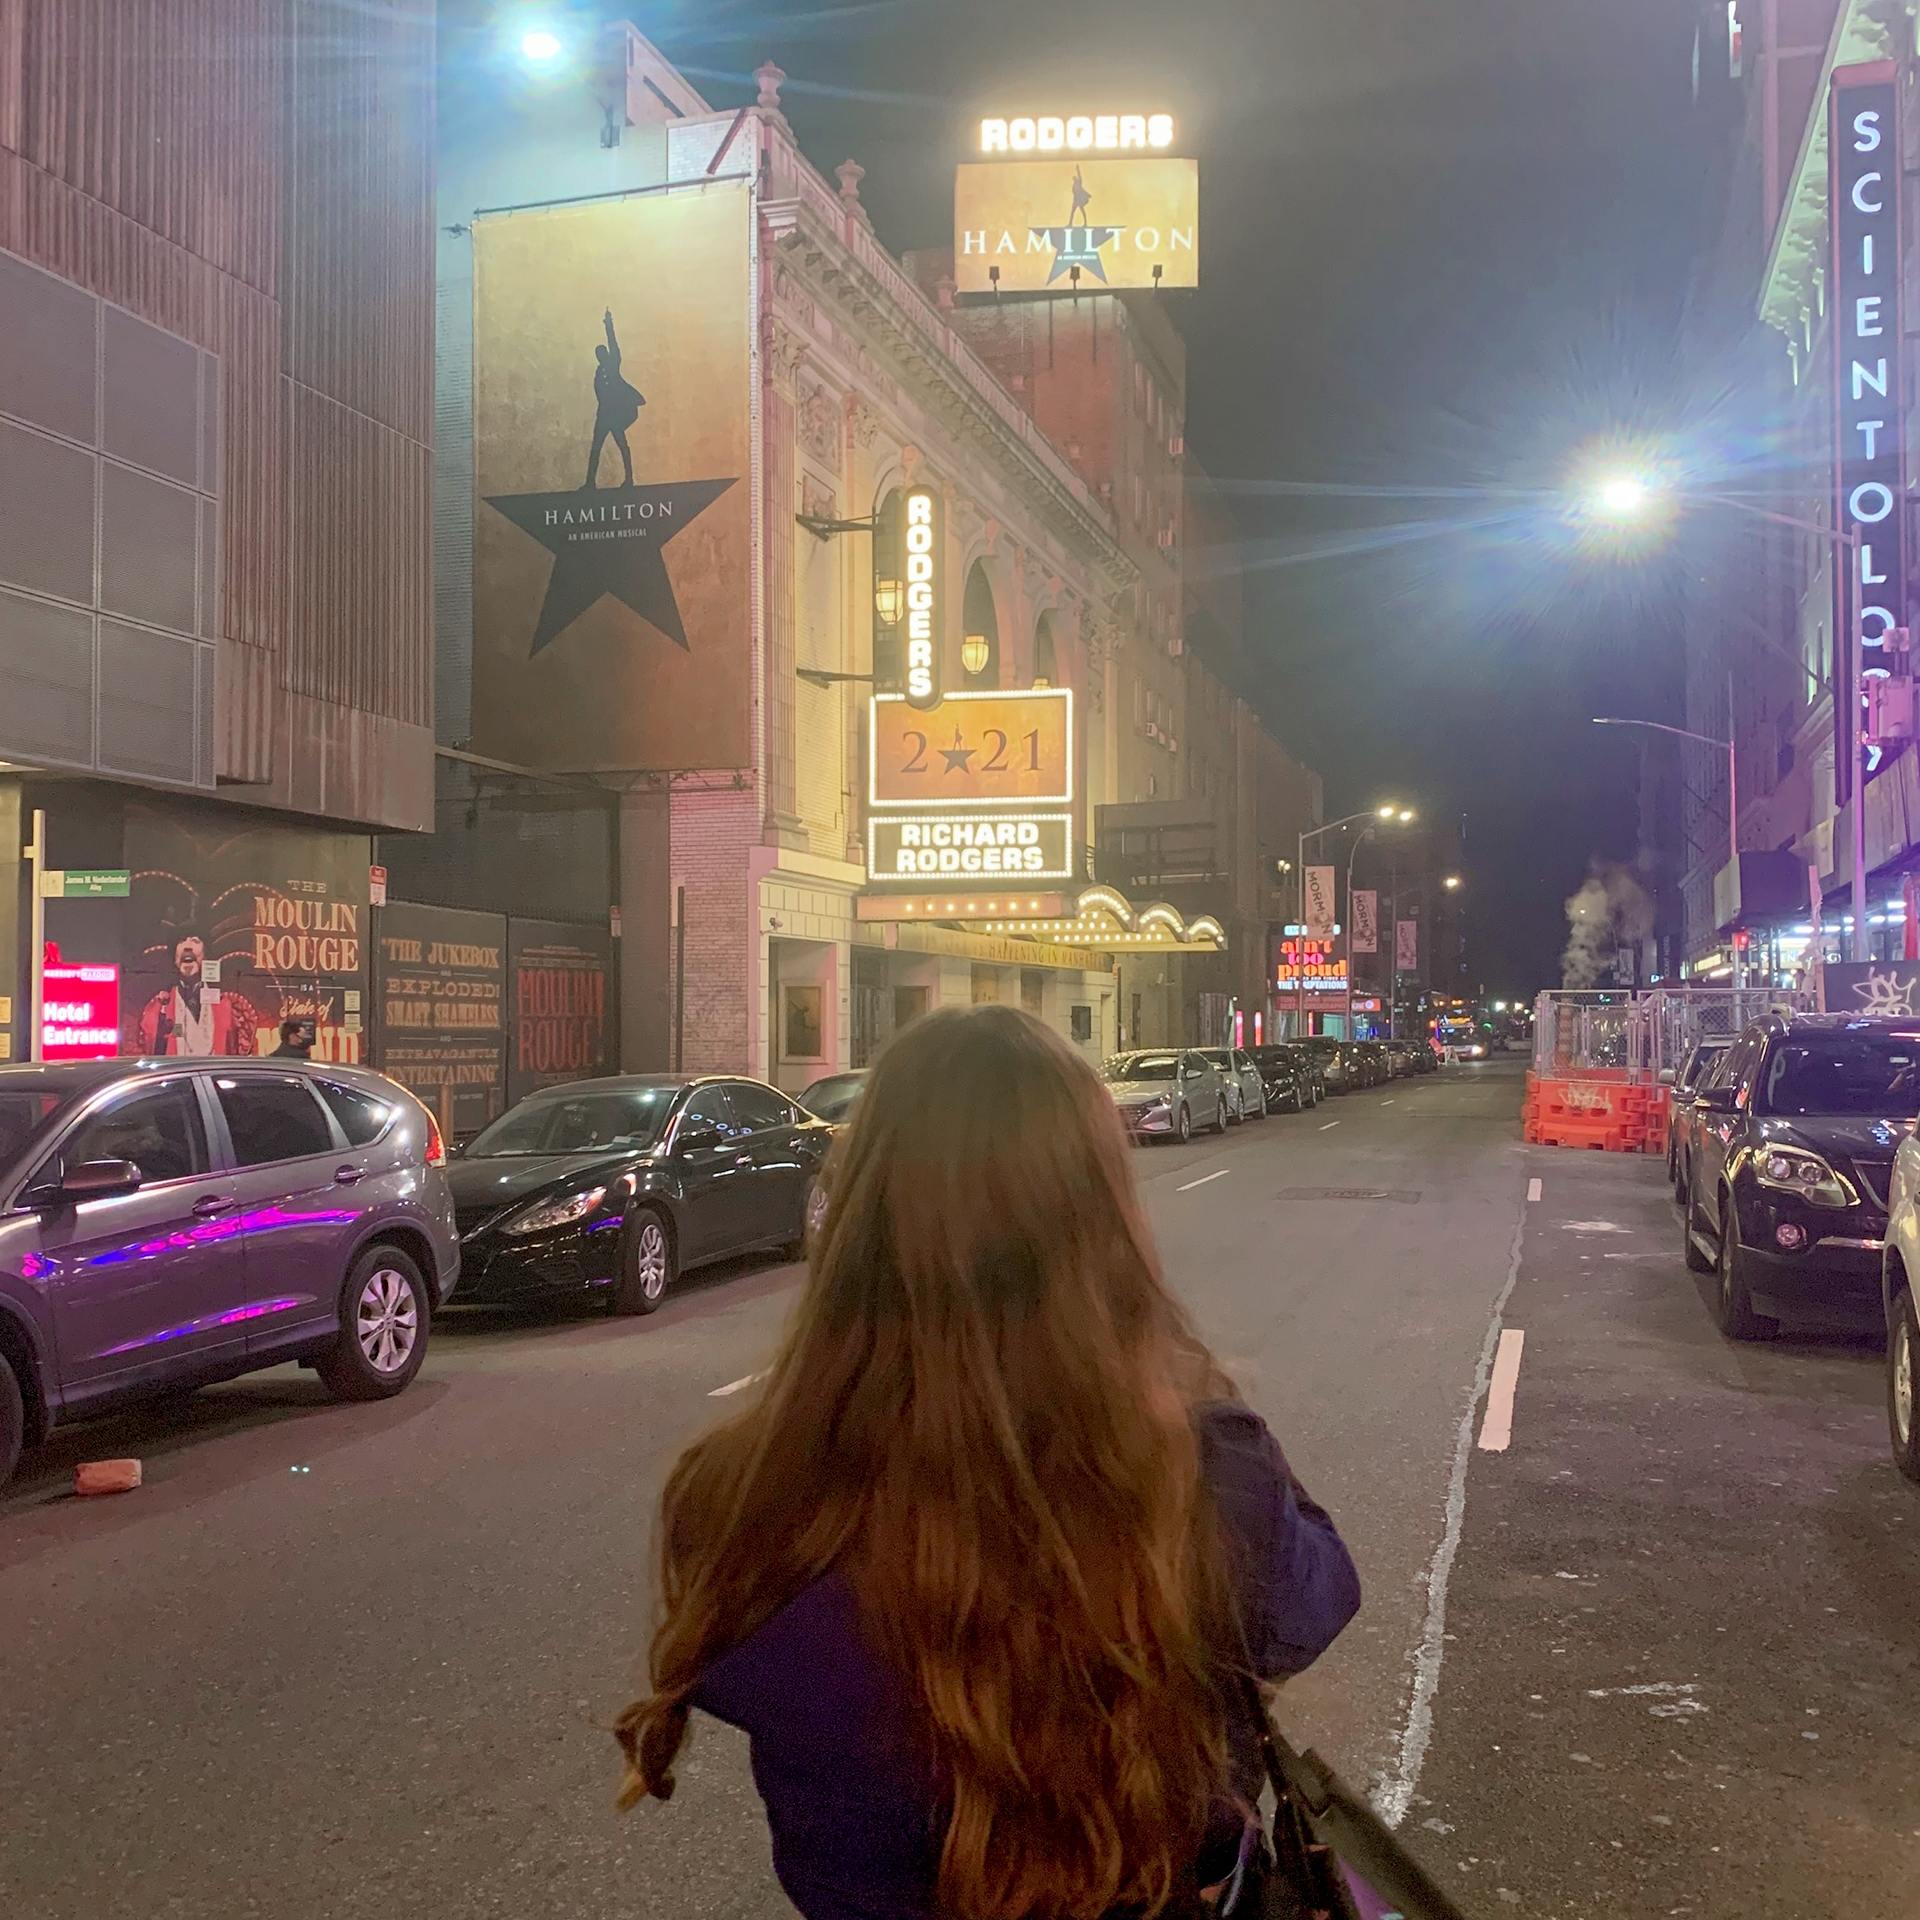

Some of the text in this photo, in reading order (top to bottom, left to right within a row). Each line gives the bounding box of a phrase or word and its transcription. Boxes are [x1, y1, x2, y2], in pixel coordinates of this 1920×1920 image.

[981, 114, 1173, 151] RODGERS
[963, 226, 1194, 254] HAMILTON
[545, 501, 673, 525] HAMILTON
[568, 528, 647, 541] AN AMERICAN MUSICAL
[907, 495, 933, 697] RODGERS
[901, 822, 1039, 847] RICHARD
[897, 846, 1044, 873] RODGERS
[287, 879, 327, 893] THE
[254, 896, 358, 933] MOULIN
[1306, 871, 1333, 935] MORMON
[1353, 894, 1375, 947] MORMON
[254, 933, 359, 972] ROUGE
[427, 942, 500, 969] JUKEBOX
[1280, 937, 1332, 954] ain't
[1288, 953, 1324, 965] too
[1277, 959, 1347, 981] proud
[300, 984, 307, 992] IS
[518, 967, 594, 1017] MOULIN
[1277, 981, 1348, 990] THE TMPTATIONS
[44, 1002, 90, 1022] Hotel
[279, 995, 316, 1018] State
[317, 996, 334, 1022] of
[43, 1026, 117, 1046] Entrance
[255, 1026, 364, 1065] MND
